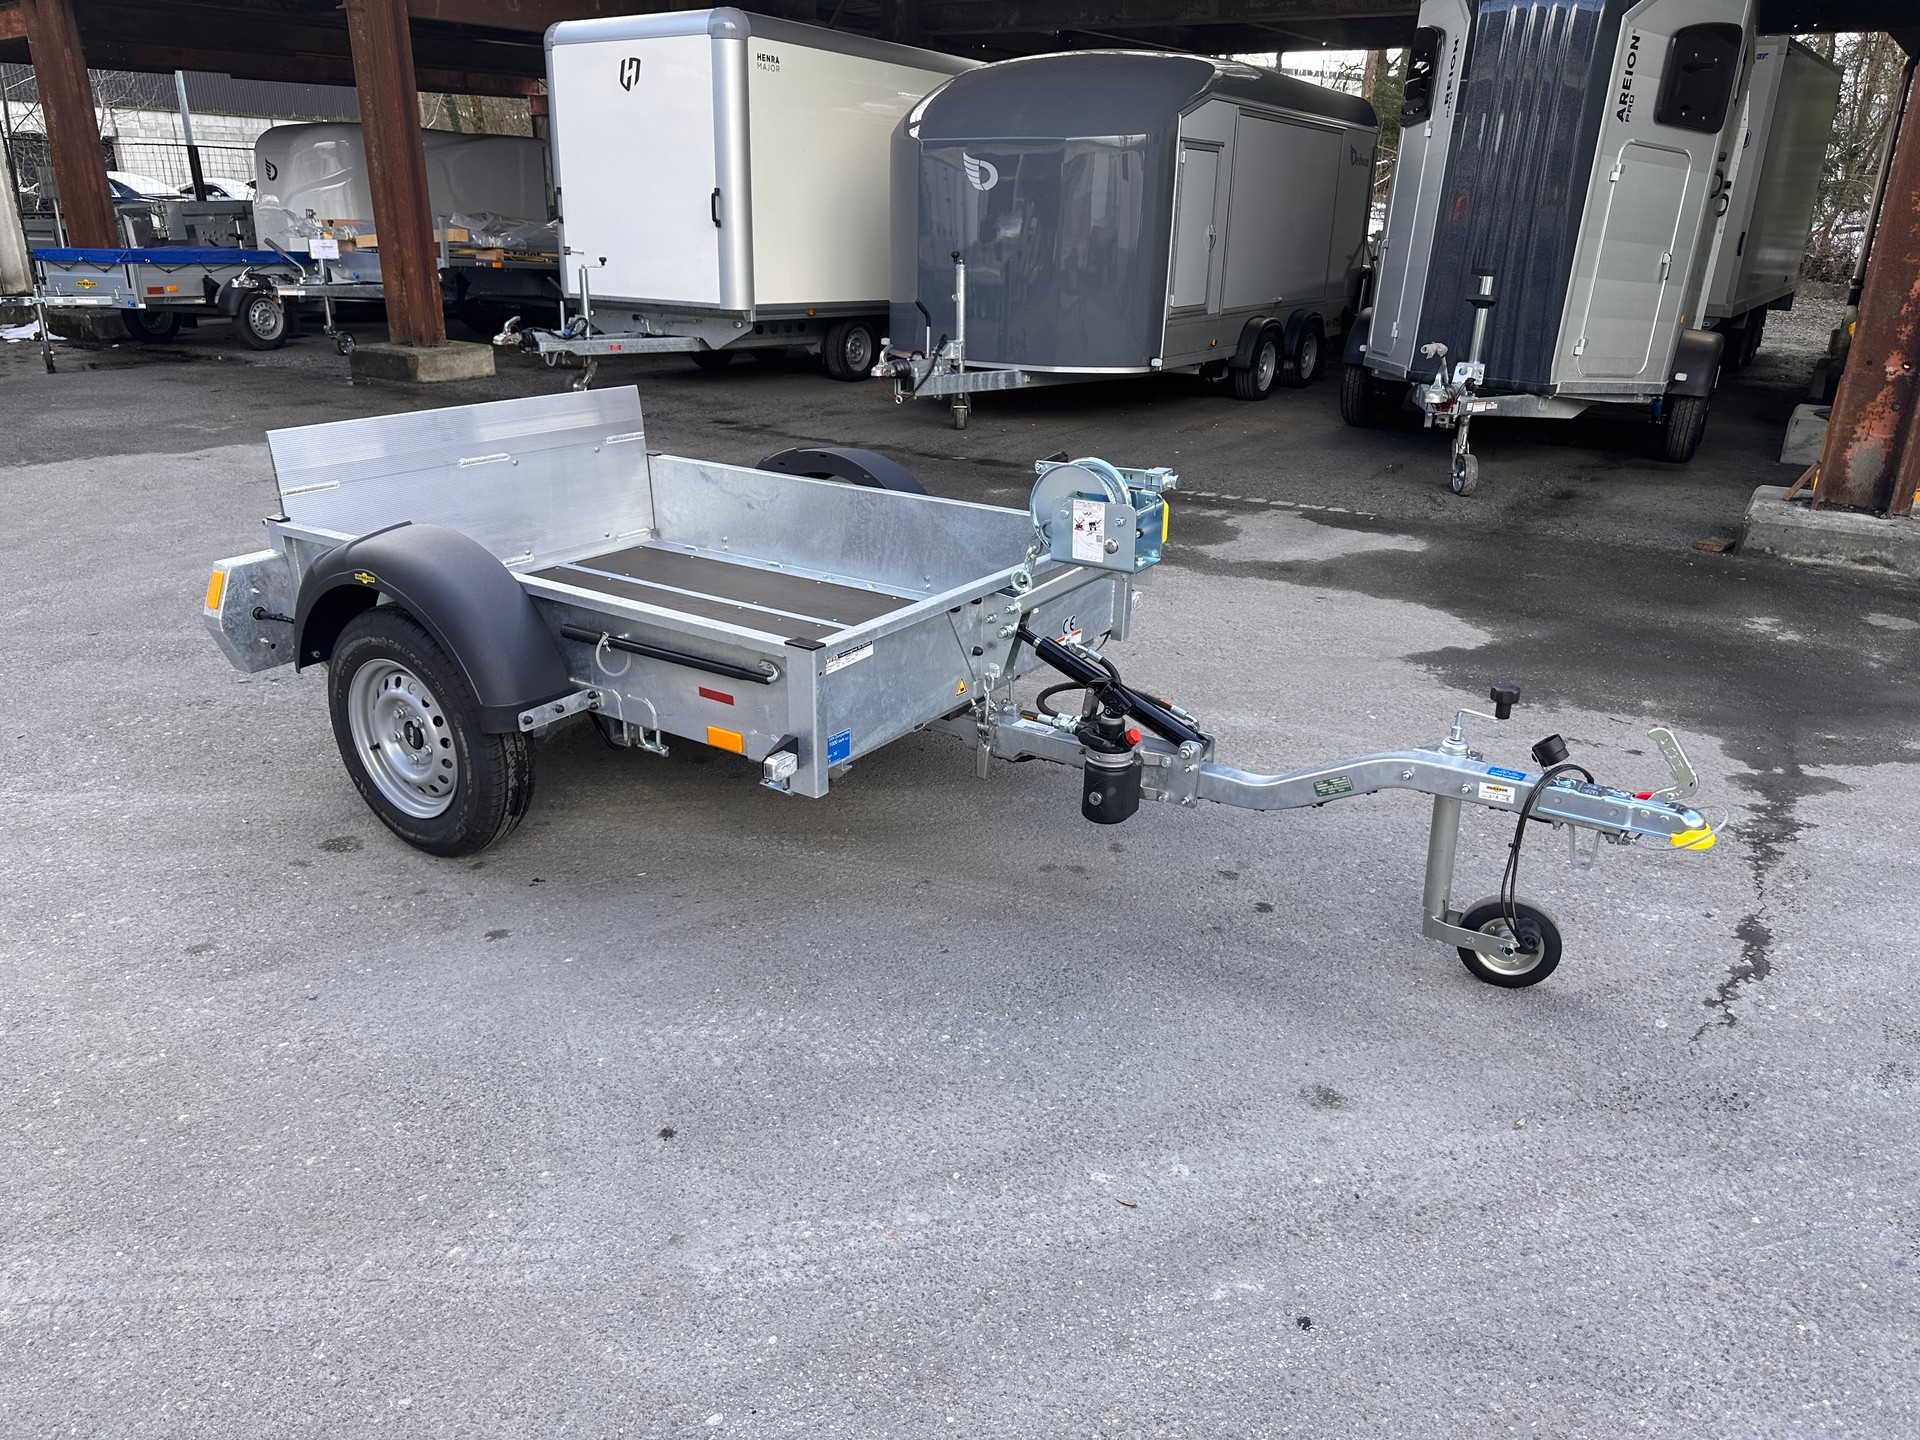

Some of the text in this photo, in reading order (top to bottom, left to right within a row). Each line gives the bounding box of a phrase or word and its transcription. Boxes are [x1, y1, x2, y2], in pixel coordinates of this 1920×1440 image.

[756, 53, 780, 65] HENRA
[756, 62, 781, 72] MAJOR
[1616, 34, 1641, 123] AREION
[1624, 94, 1636, 123] PRO
[1062, 615, 1076, 635] CE
